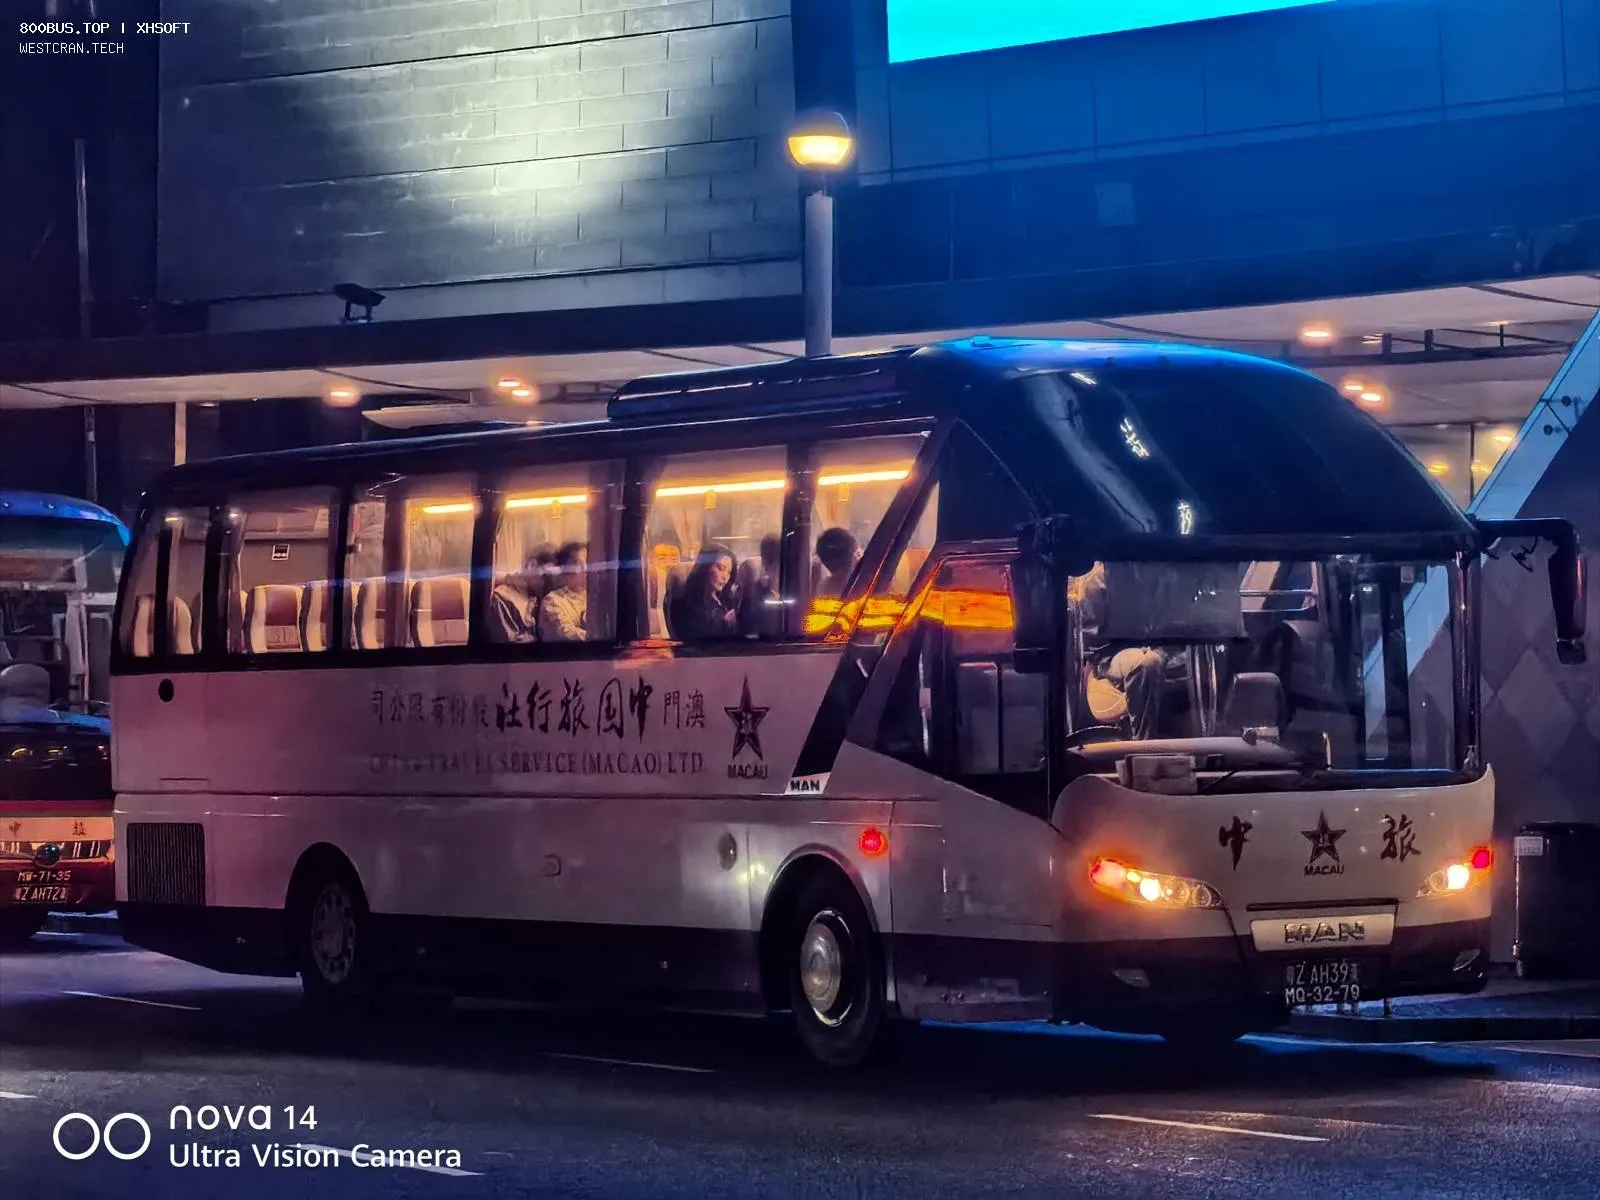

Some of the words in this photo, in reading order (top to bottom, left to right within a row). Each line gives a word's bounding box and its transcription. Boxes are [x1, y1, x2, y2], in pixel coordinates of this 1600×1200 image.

[499, 751, 575, 774] SERVICE
[583, 750, 662, 775] (MACAO)
[727, 764, 768, 779] MACAU
[790, 780, 820, 793] MAN
[1218, 815, 1252, 872] 中
[1304, 865, 1345, 877] MACAU
[1284, 920, 1366, 945] MAN
